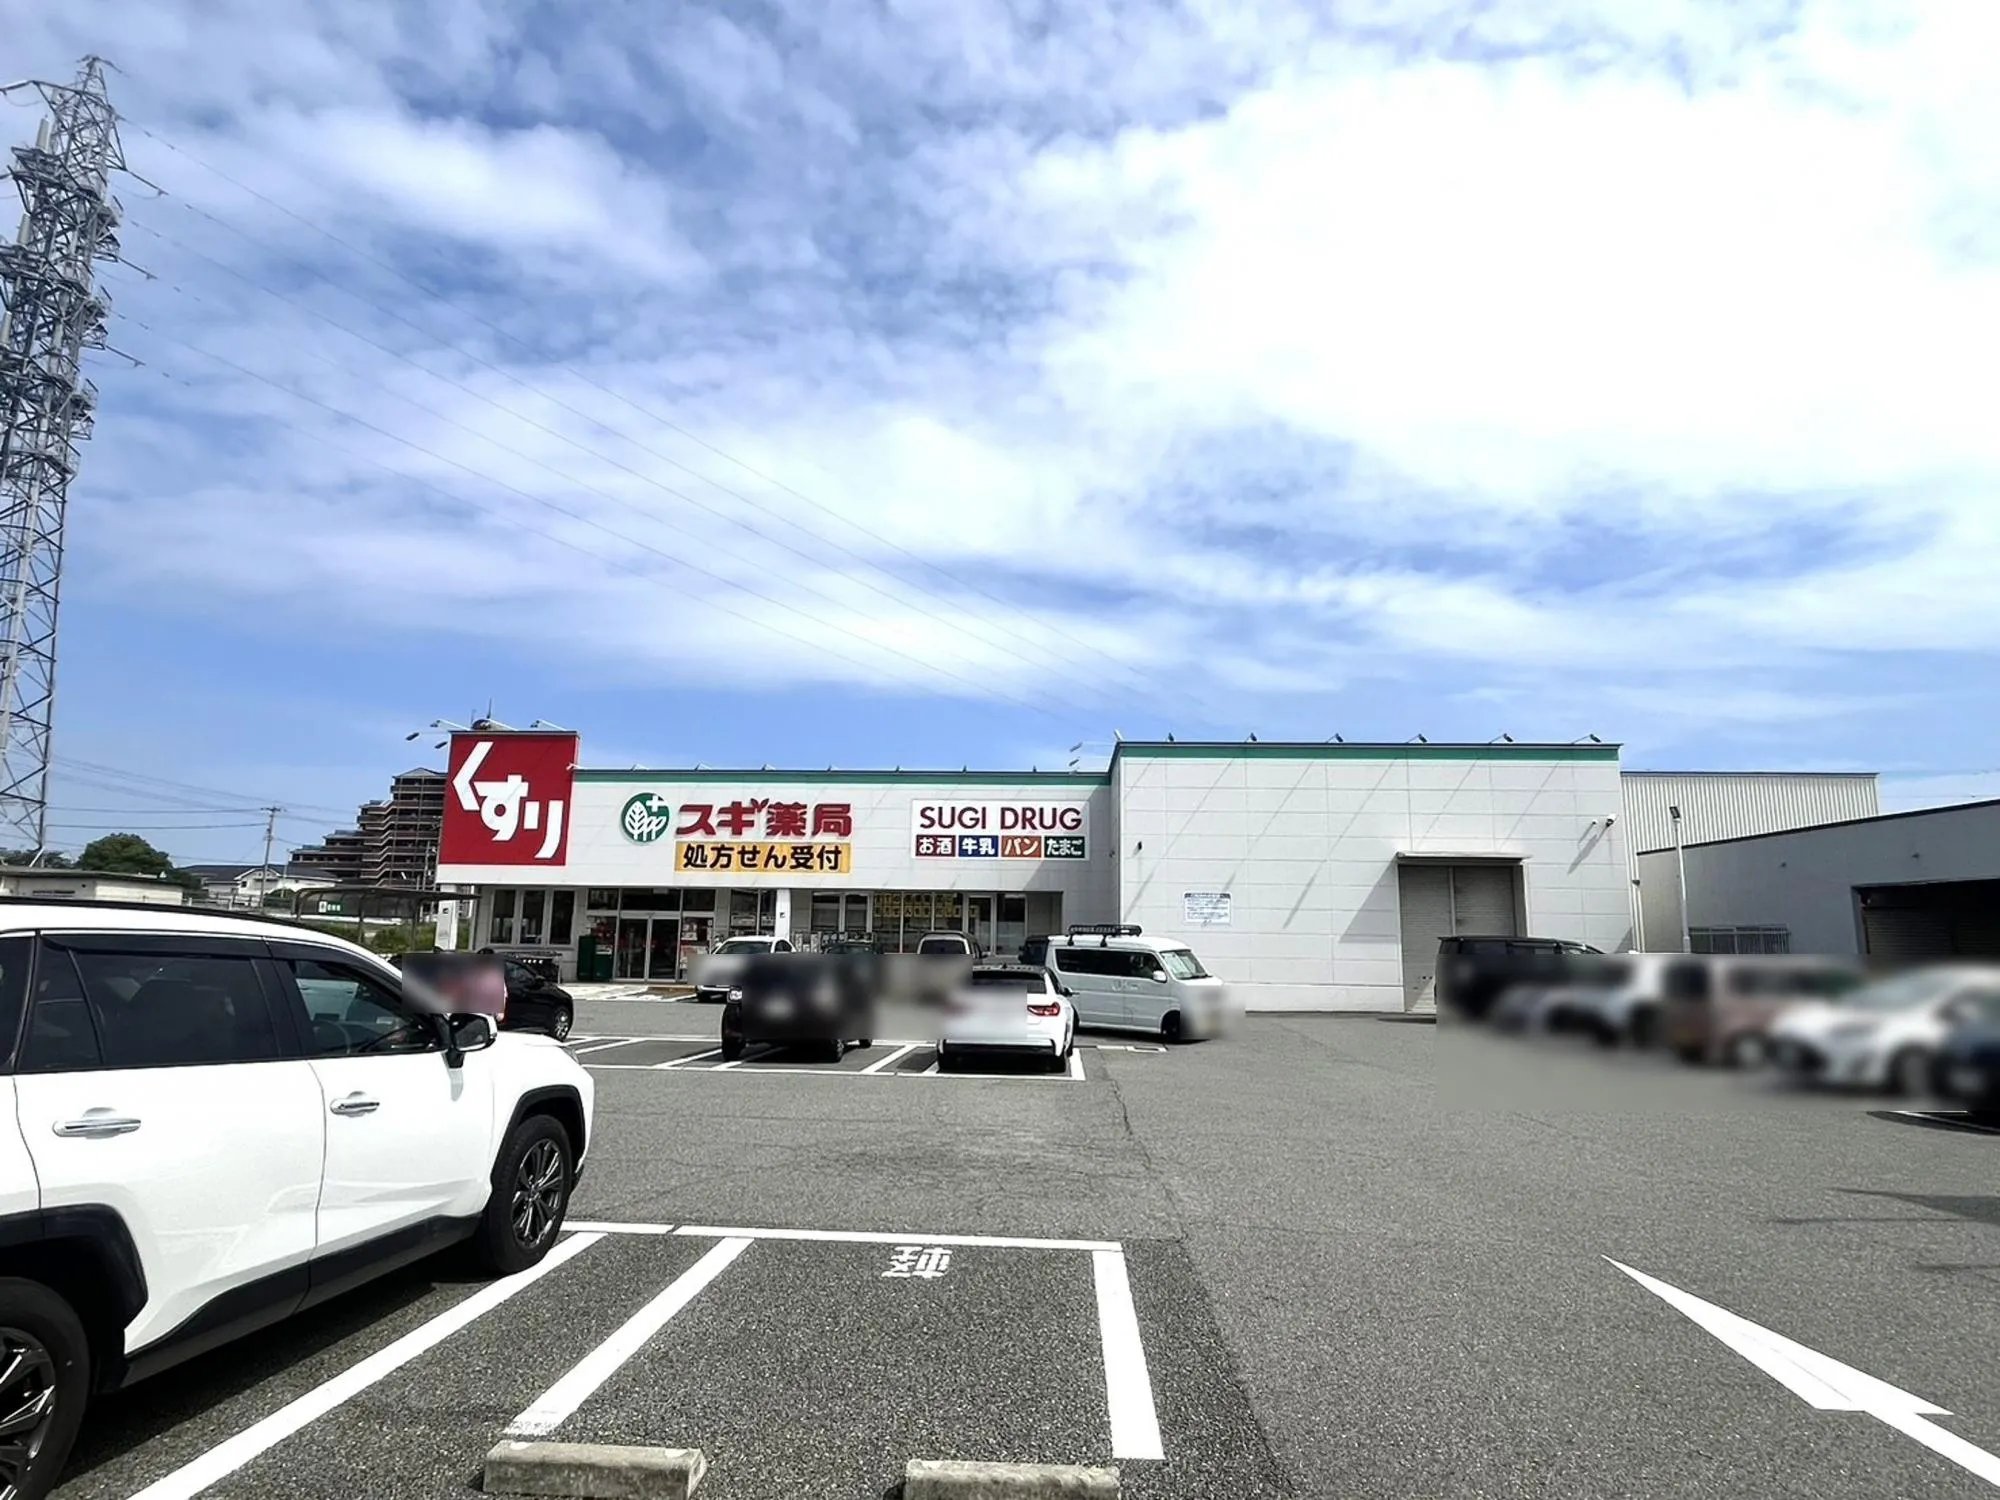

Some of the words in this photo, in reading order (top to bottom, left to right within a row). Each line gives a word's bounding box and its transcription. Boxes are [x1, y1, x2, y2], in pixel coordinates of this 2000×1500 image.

[452, 741, 564, 859] くすり
[675, 798, 852, 837] スギ薬局
[919, 806, 987, 830] SUGI
[1000, 807, 1083, 831] DRUG
[683, 843, 842, 870] 処方せん受付
[918, 837, 953, 855] お酒
[961, 838, 996, 855] 牛乳
[1004, 839, 1039, 856] パン
[1046, 839, 1083, 856] たまご
[881, 1246, 952, 1278] 軽
